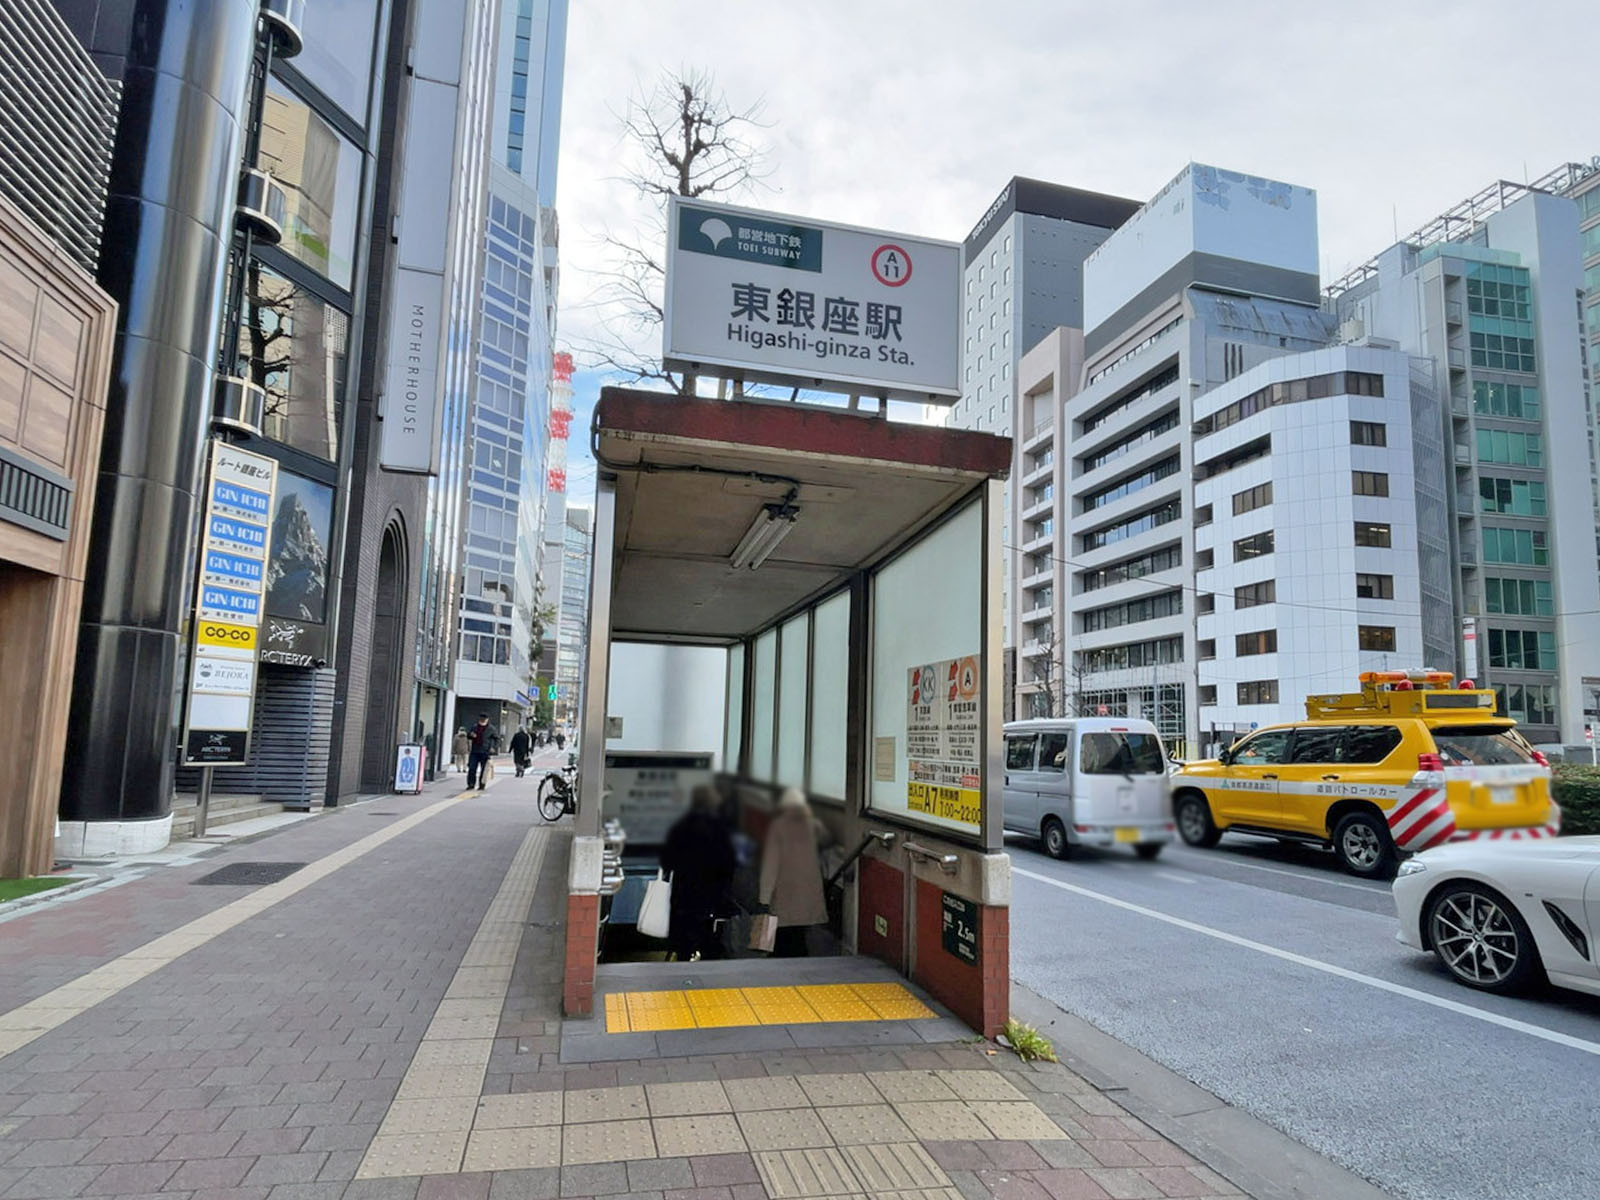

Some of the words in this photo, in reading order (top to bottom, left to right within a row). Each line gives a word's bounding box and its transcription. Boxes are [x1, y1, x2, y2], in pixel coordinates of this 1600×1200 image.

[738, 227, 802, 249] 都営地下鉄
[738, 241, 760, 254] TOEI
[761, 244, 801, 260] SUBWAY
[886, 251, 898, 265] A
[883, 264, 900, 279] 11
[730, 282, 903, 342] 東銀座駅
[727, 323, 871, 359] Higashi-ginza
[878, 345, 915, 366] Sta.
[403, 304, 424, 434] MOTHERHOUSE
[205, 626, 251, 641] CO-CO
[923, 676, 934, 692] KK
[964, 671, 972, 686] A
[924, 786, 938, 815] A7
